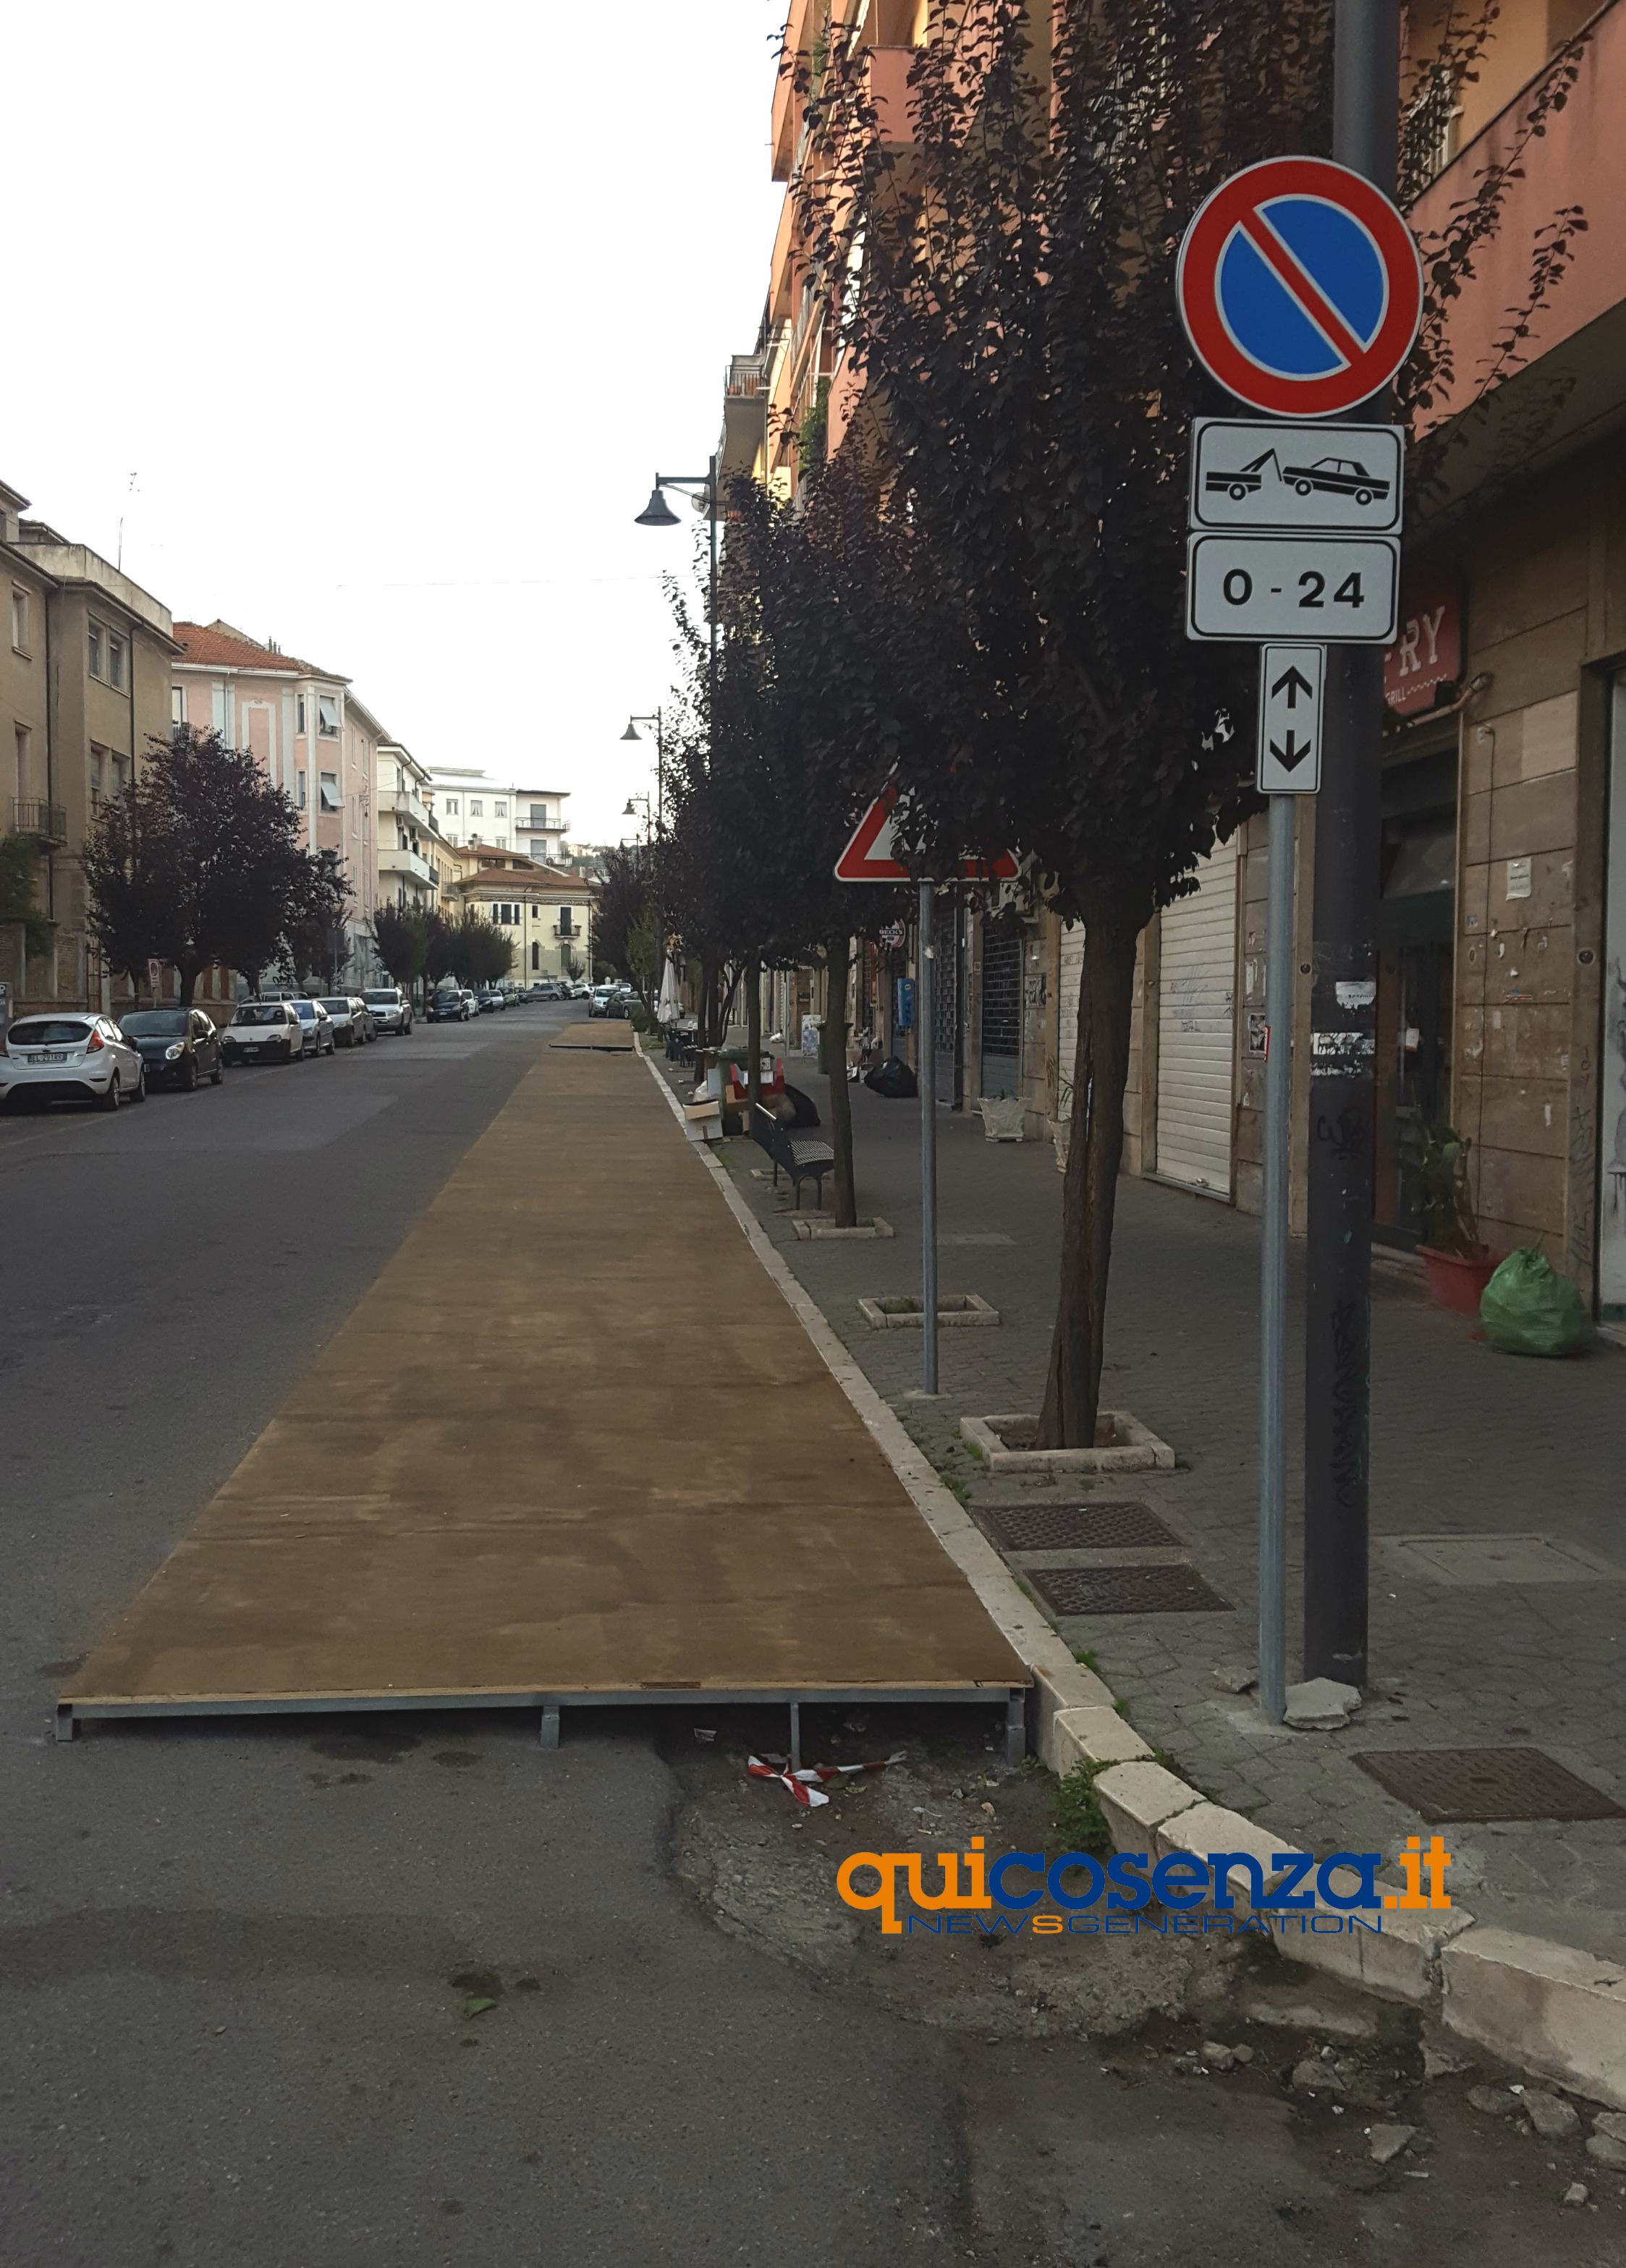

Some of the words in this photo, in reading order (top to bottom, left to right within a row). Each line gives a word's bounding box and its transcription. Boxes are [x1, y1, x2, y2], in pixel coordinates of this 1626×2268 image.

[1223, 568, 1253, 606] 0
[1297, 570, 1365, 608] 24
[1385, 605, 1446, 677] RY
